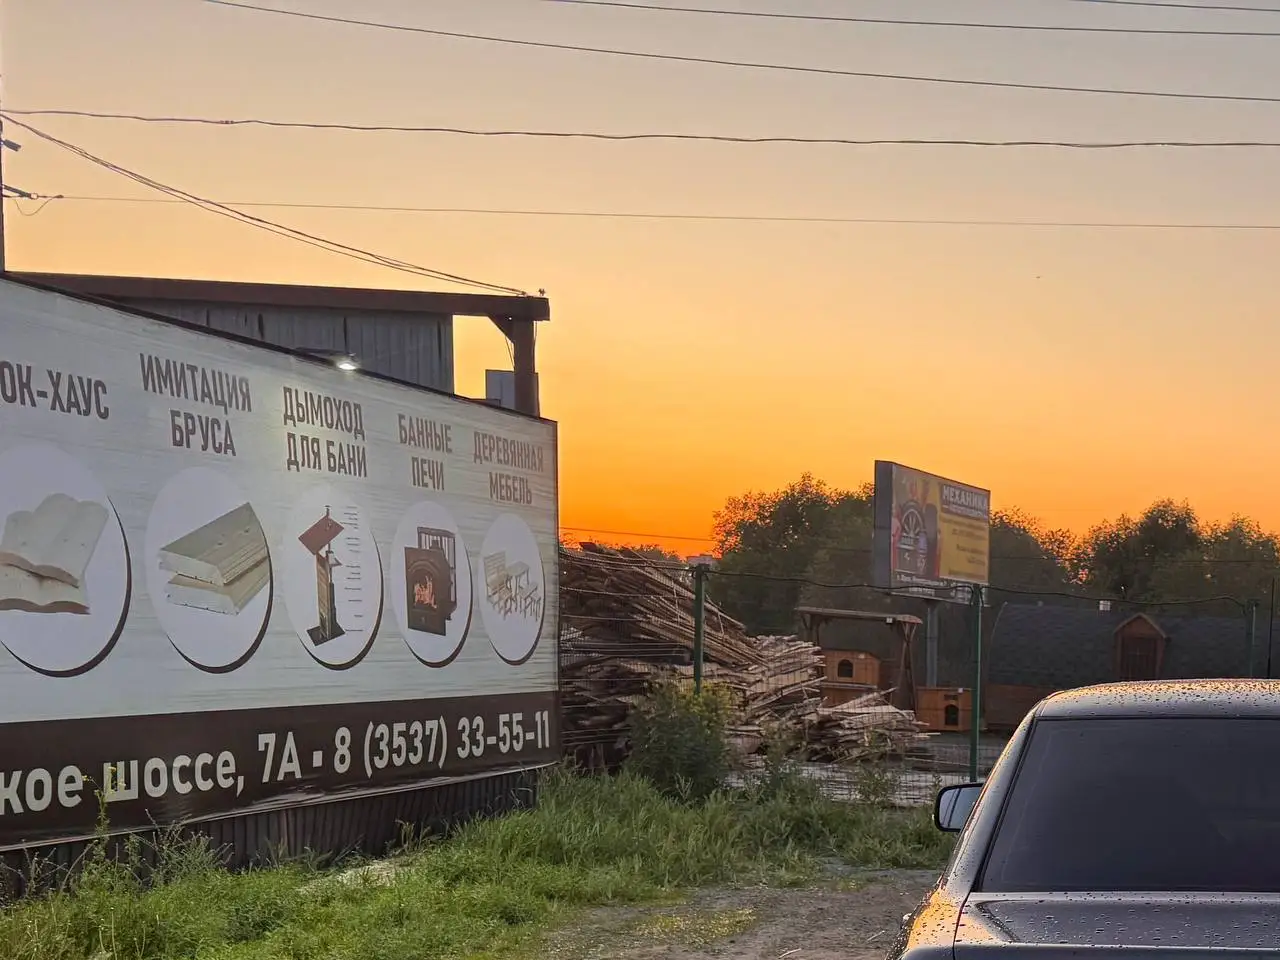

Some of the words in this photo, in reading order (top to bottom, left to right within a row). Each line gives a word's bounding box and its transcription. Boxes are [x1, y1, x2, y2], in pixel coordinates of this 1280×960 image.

[0, 361, 109, 419] ОК-ХАУС
[139, 353, 252, 414] ИМИТАЦИЯ
[170, 409, 237, 456] БРУСА
[283, 386, 365, 441] ДЫМОХОД
[398, 413, 453, 453] БАННЫЕ
[287, 432, 322, 472] ДЛЯ
[326, 440, 368, 478] БАНИ
[411, 457, 445, 490] ПЕЧИ
[473, 431, 544, 473] ДЕРЕВЯННАЯ
[489, 471, 532, 504] МЕБЕЛЬ
[103, 750, 245, 803] шоссе,
[334, 726, 351, 774] 8
[364, 715, 447, 778] (3537)
[457, 710, 550, 759] 33-55-11
